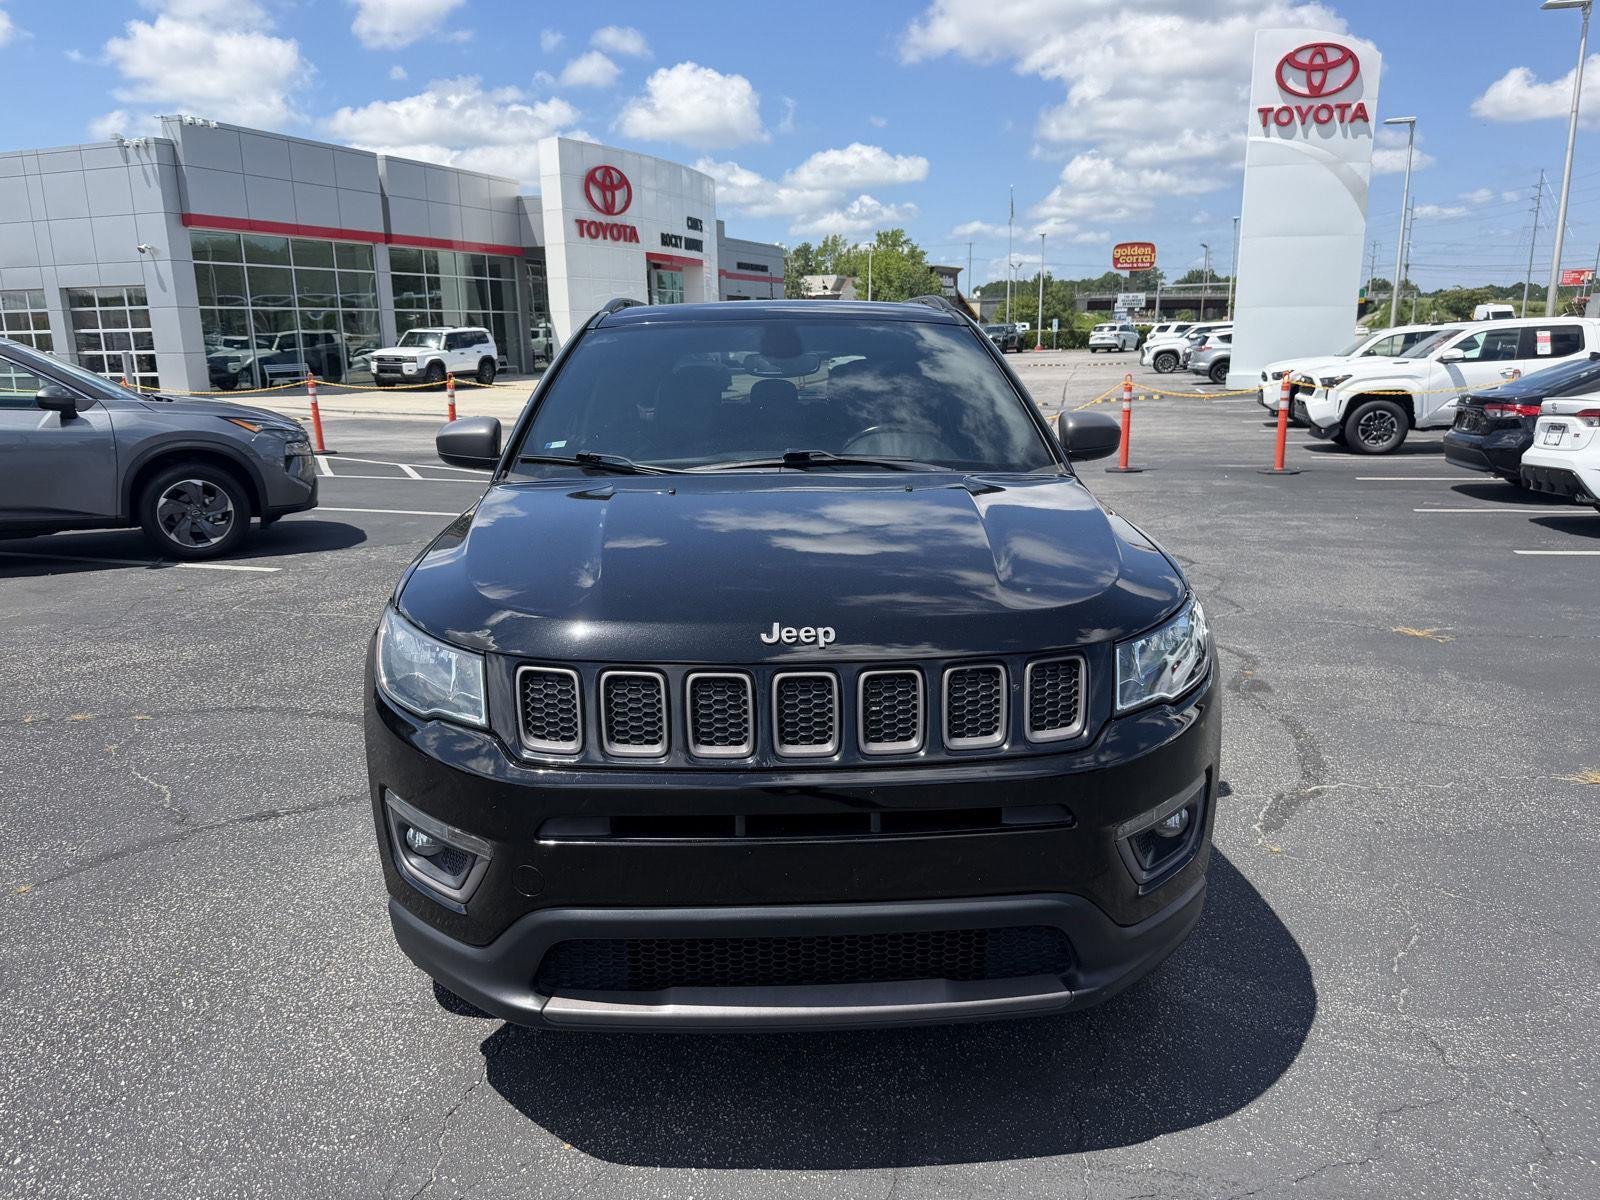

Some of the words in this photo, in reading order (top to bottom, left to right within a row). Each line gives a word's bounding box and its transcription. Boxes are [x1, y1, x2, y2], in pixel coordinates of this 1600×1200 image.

[1258, 102, 1369, 127] TOYOTA
[575, 218, 640, 243] TOYOTA
[660, 232, 683, 249] ROCKY
[1114, 245, 1152, 258] golden
[1119, 253, 1155, 263] corral
[760, 622, 836, 649] Jeep
